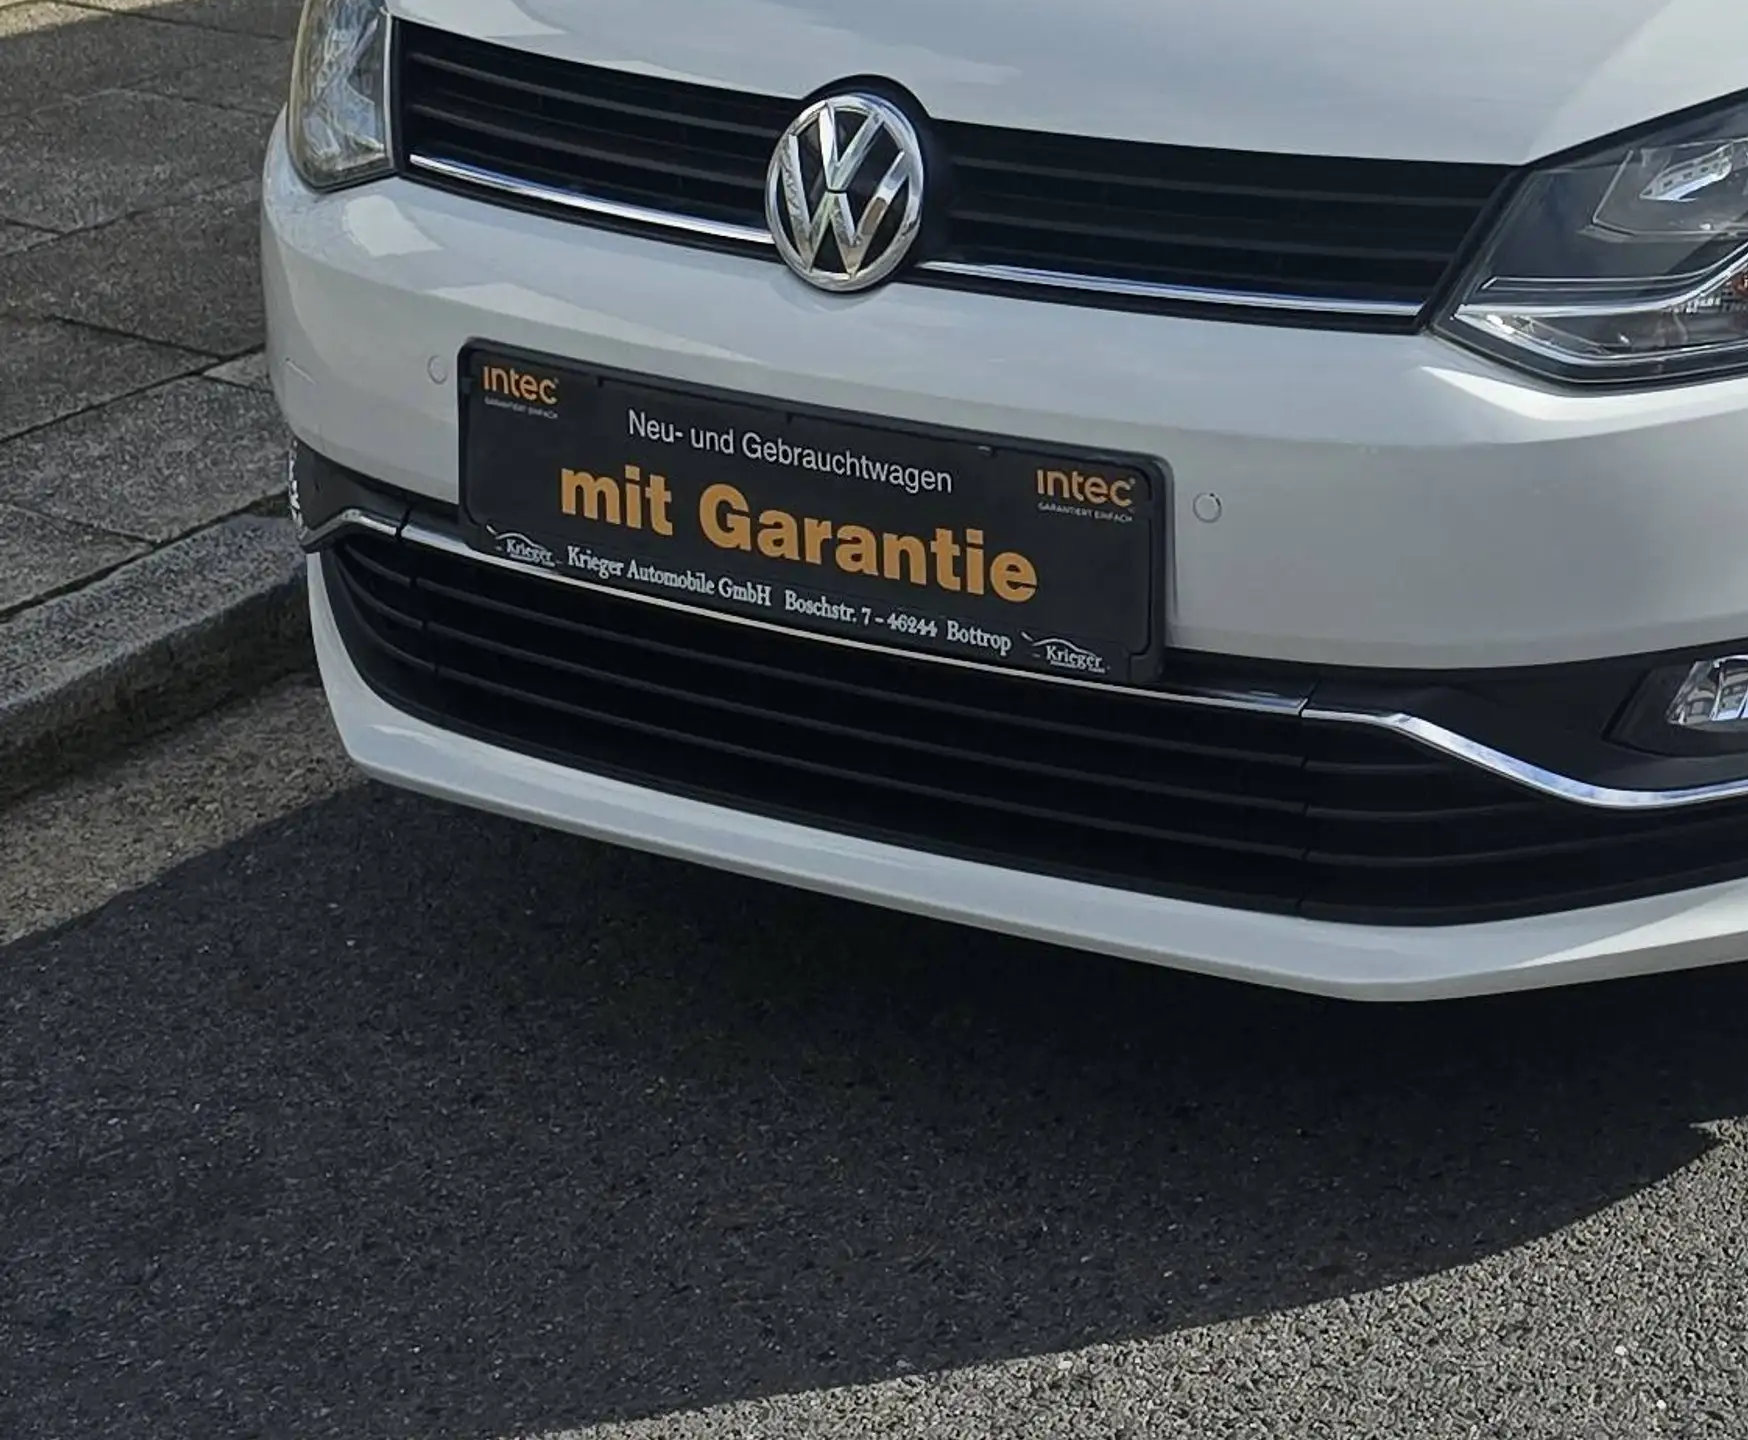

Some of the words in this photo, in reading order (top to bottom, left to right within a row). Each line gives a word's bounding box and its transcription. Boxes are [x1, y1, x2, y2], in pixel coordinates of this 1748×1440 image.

[483, 365, 557, 405] intec
[628, 408, 684, 443] Neu-
[690, 427, 735, 455] und
[741, 431, 953, 494] Gebrauchtwagen
[1036, 469, 1132, 508] intec
[560, 463, 674, 537] mit
[698, 481, 1038, 605] Garantie
[567, 545, 625, 579] Krieger
[627, 559, 715, 595] Automobile
[717, 576, 772, 608] GmbH
[784, 588, 857, 623] Boschstr.
[861, 606, 873, 627] 7
[886, 612, 938, 638] 46244
[946, 618, 1013, 657] Bottrop
[1045, 644, 1103, 670] Krieger
